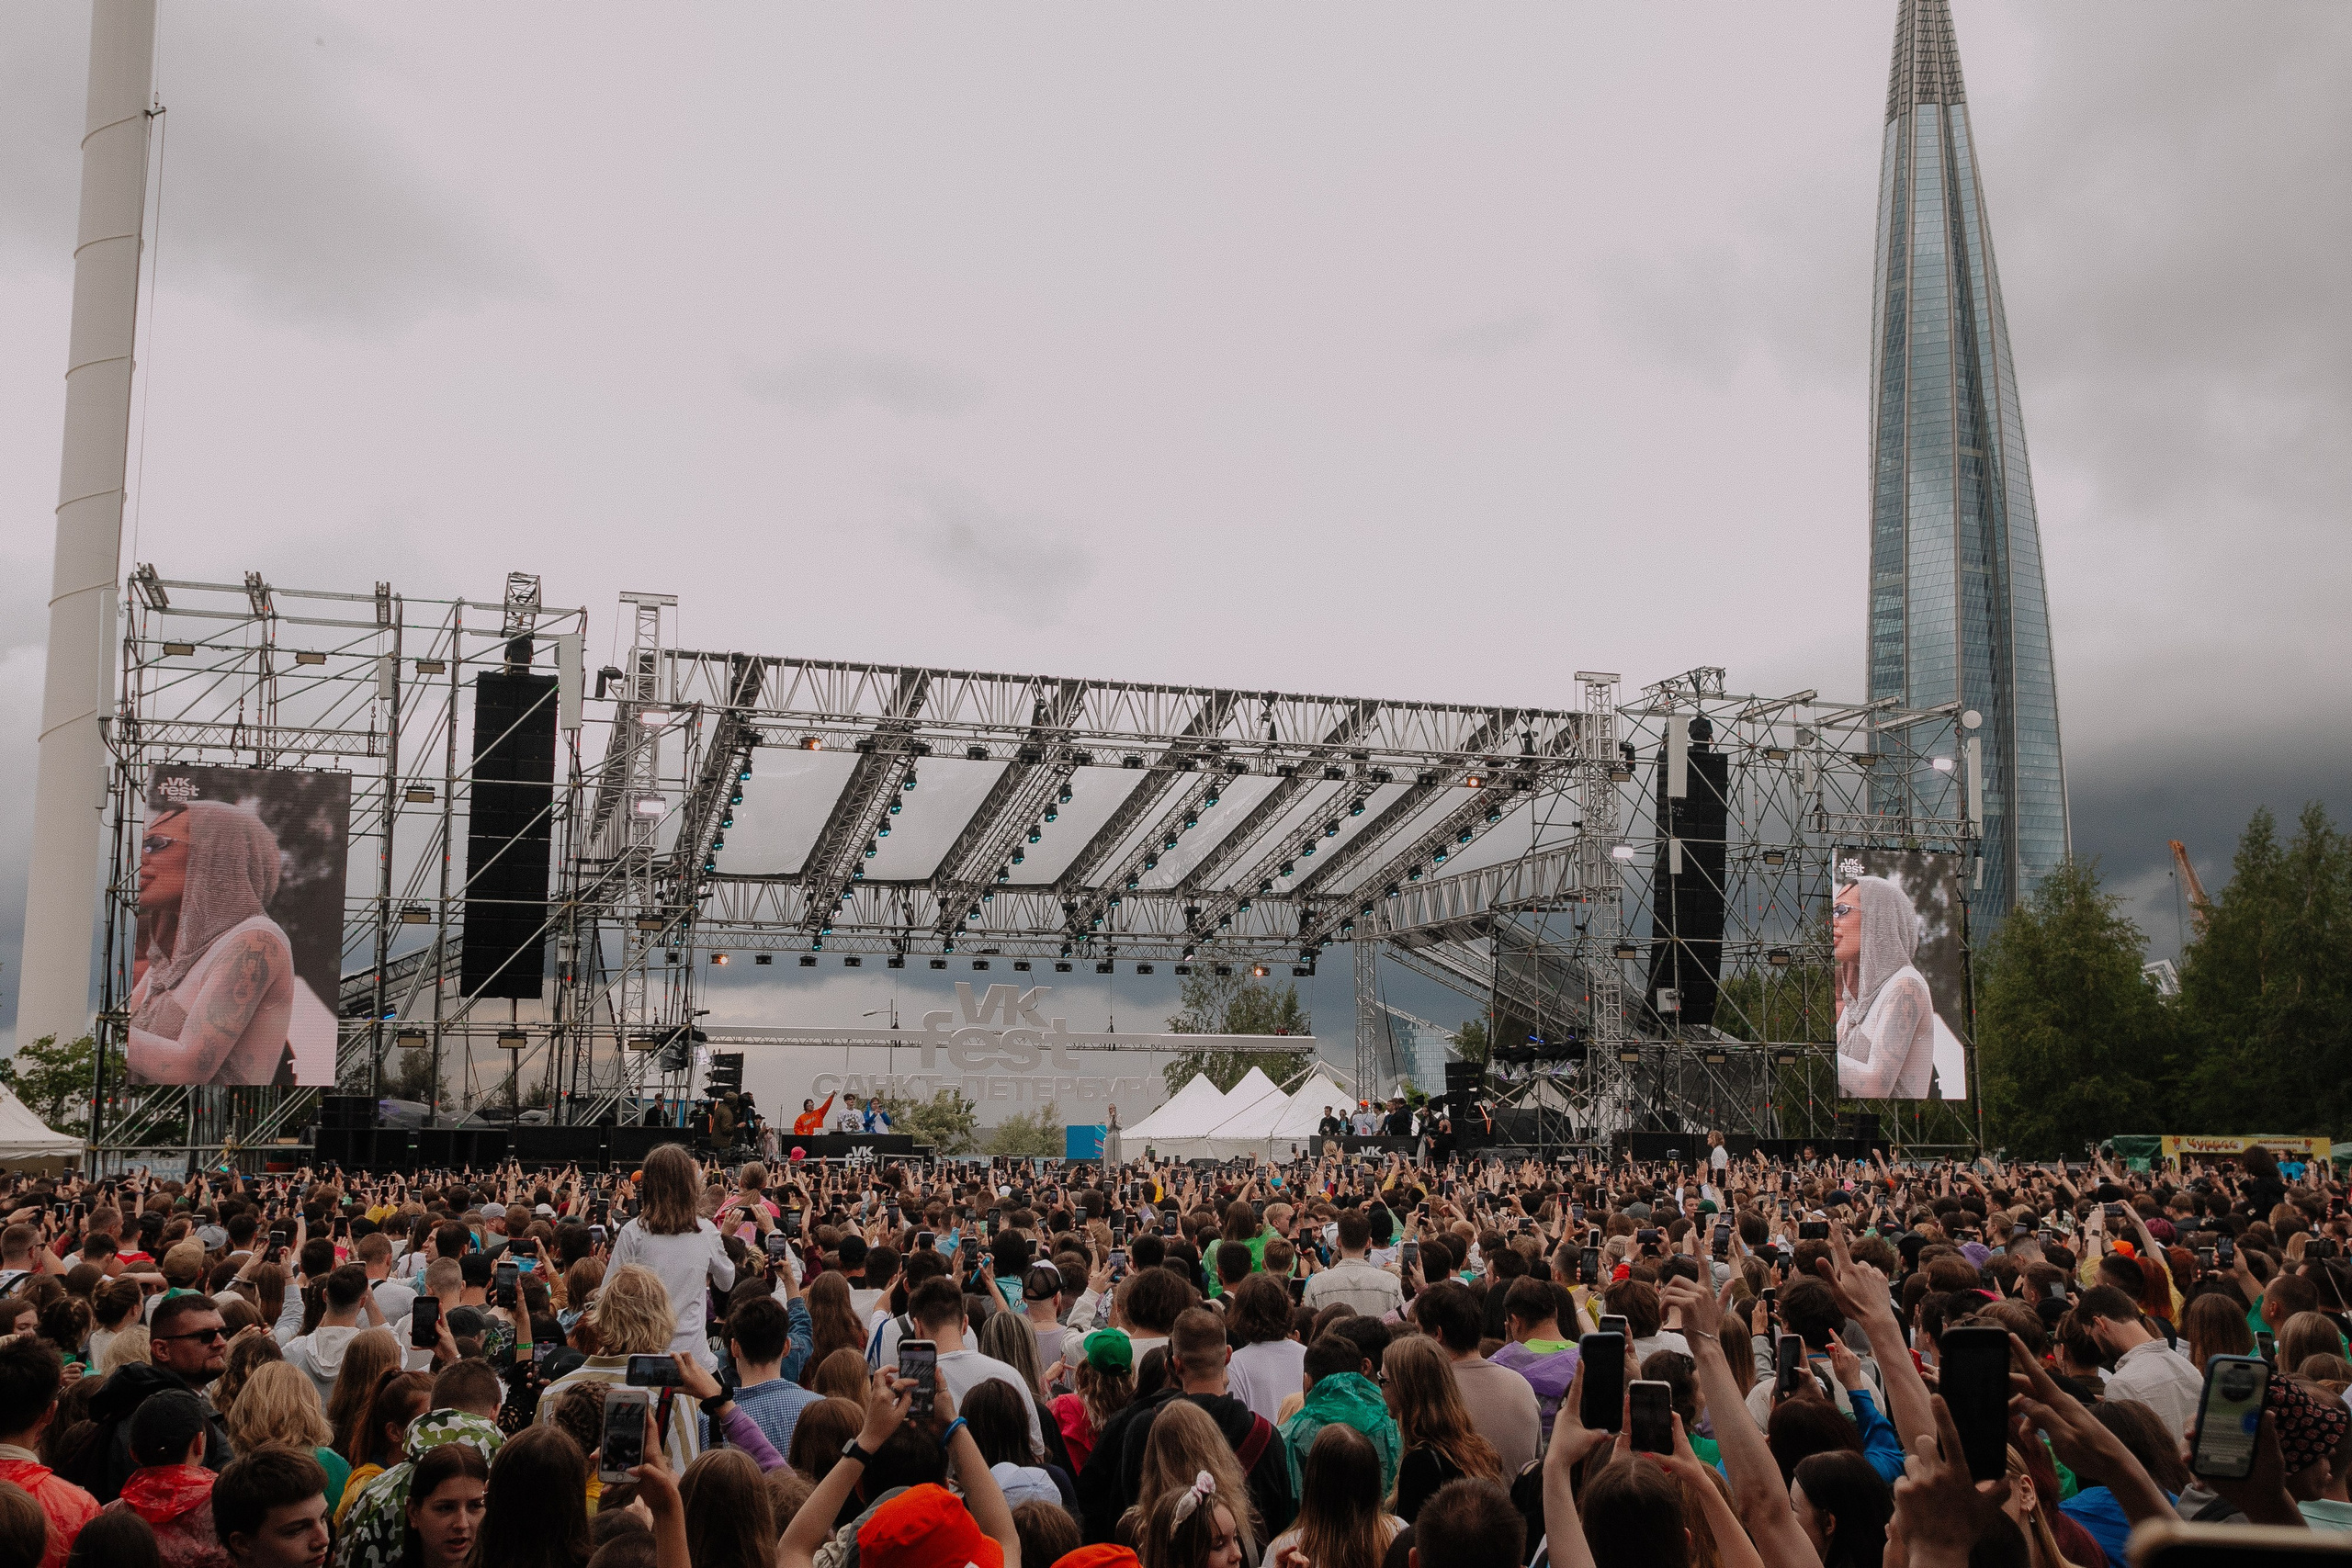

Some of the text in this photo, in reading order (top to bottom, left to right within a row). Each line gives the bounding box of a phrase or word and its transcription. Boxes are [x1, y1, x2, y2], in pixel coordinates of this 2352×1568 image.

[167, 777, 190, 787] VK
[158, 783, 199, 796] fest
[1838, 863, 1864, 873] fest
[955, 982, 1052, 1028] VK
[919, 1010, 1080, 1072] fest
[851, 1146, 874, 1156] VK
[1360, 1146, 1383, 1156] VK
